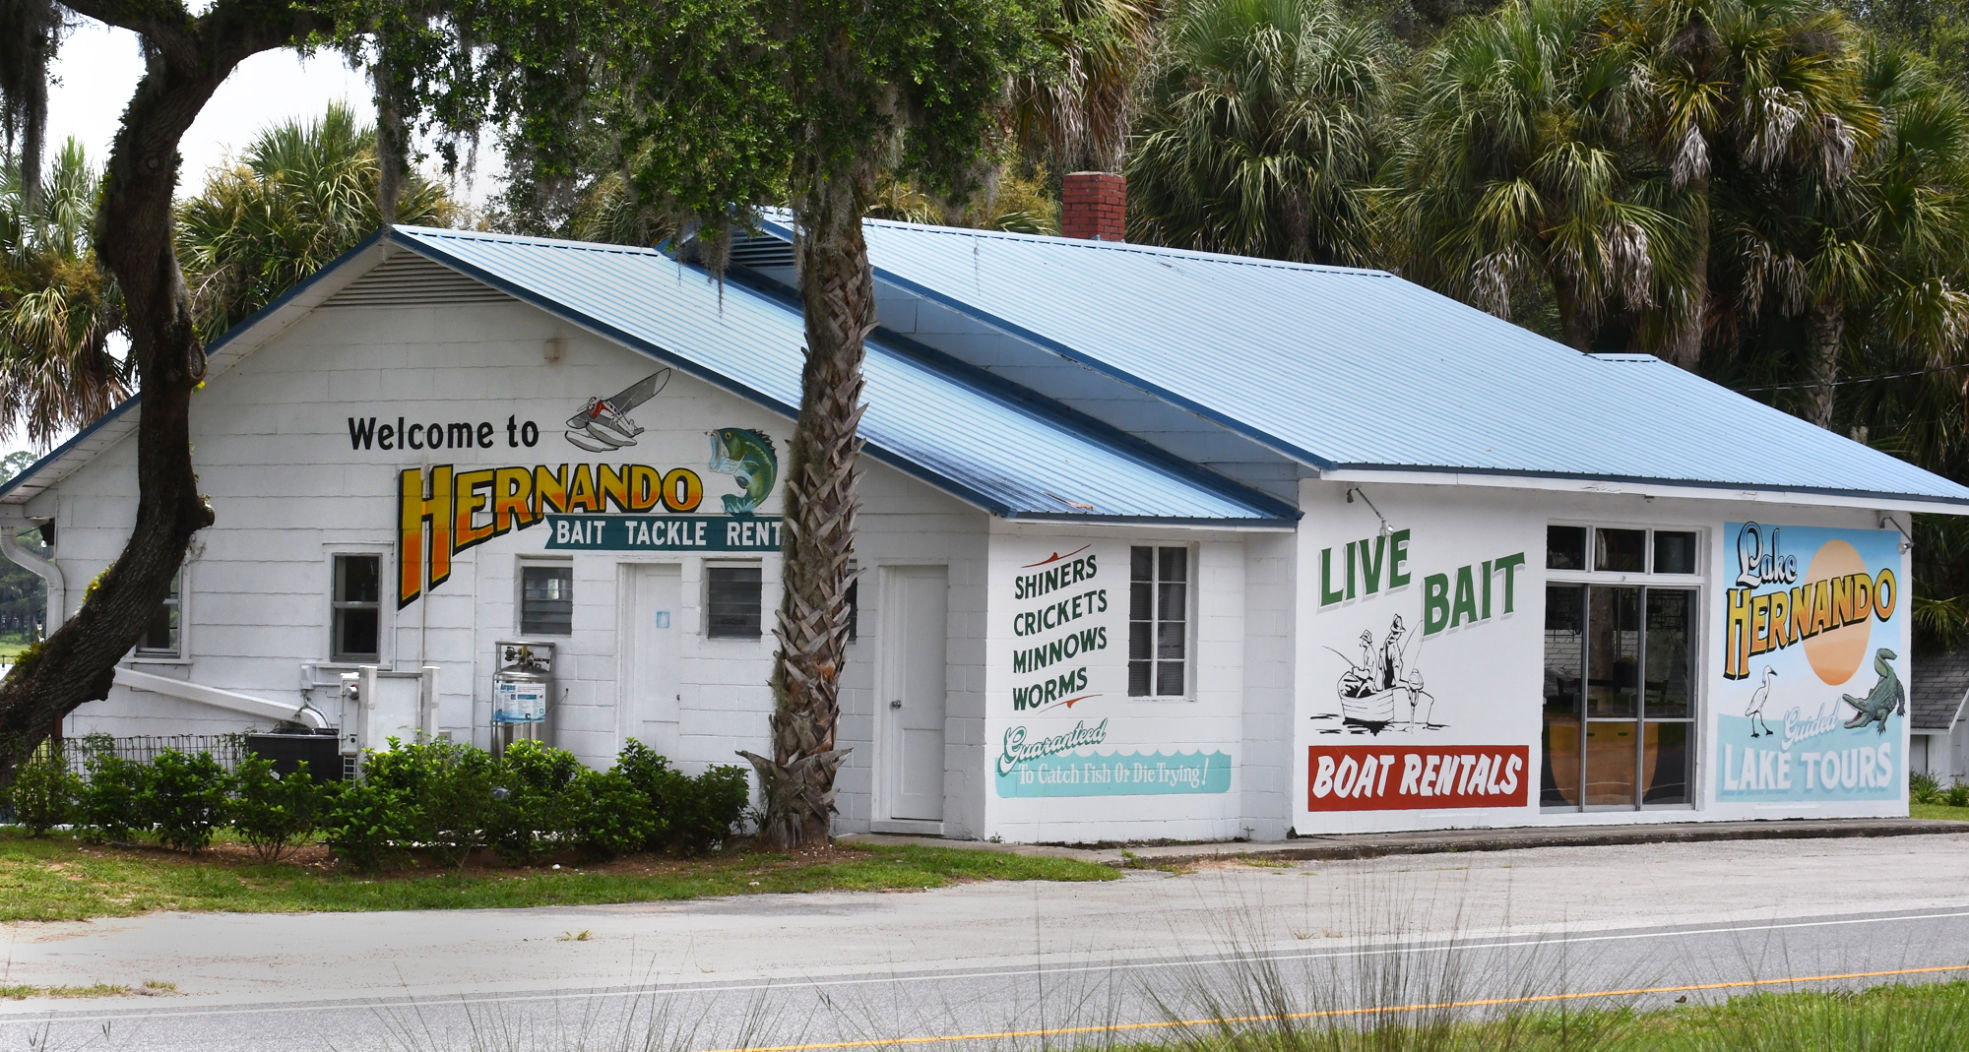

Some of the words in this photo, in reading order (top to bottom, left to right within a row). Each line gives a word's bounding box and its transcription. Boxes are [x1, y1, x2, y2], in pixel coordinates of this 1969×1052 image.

[347, 416, 494, 450] Welcome
[506, 414, 539, 448] to
[397, 463, 703, 610] HERNANDO
[556, 520, 606, 545] BAIT
[627, 520, 707, 546] TACKLE
[1736, 521, 1798, 588] Lake
[1014, 554, 1098, 600] SHINERS
[1318, 528, 1412, 610] LIVE
[1013, 589, 1108, 637] CRICKETS
[1421, 552, 1526, 638] BAIT
[1723, 568, 1897, 680] HERNANDO
[1013, 626, 1107, 674] MINNOWS
[1013, 667, 1088, 711] WORMS
[998, 717, 1108, 777] Guaranteed
[1781, 700, 1842, 750] Guided
[1018, 763, 1034, 785] To
[1038, 762, 1080, 785] Catch
[1084, 761, 1111, 784] Fish
[1114, 762, 1130, 783] Or
[1133, 761, 1155, 783] Die
[1312, 754, 1396, 799] BOAT
[1399, 753, 1523, 797] RENTALS
[1723, 744, 1792, 792] LAKE
[1800, 742, 1893, 790] TOURS
